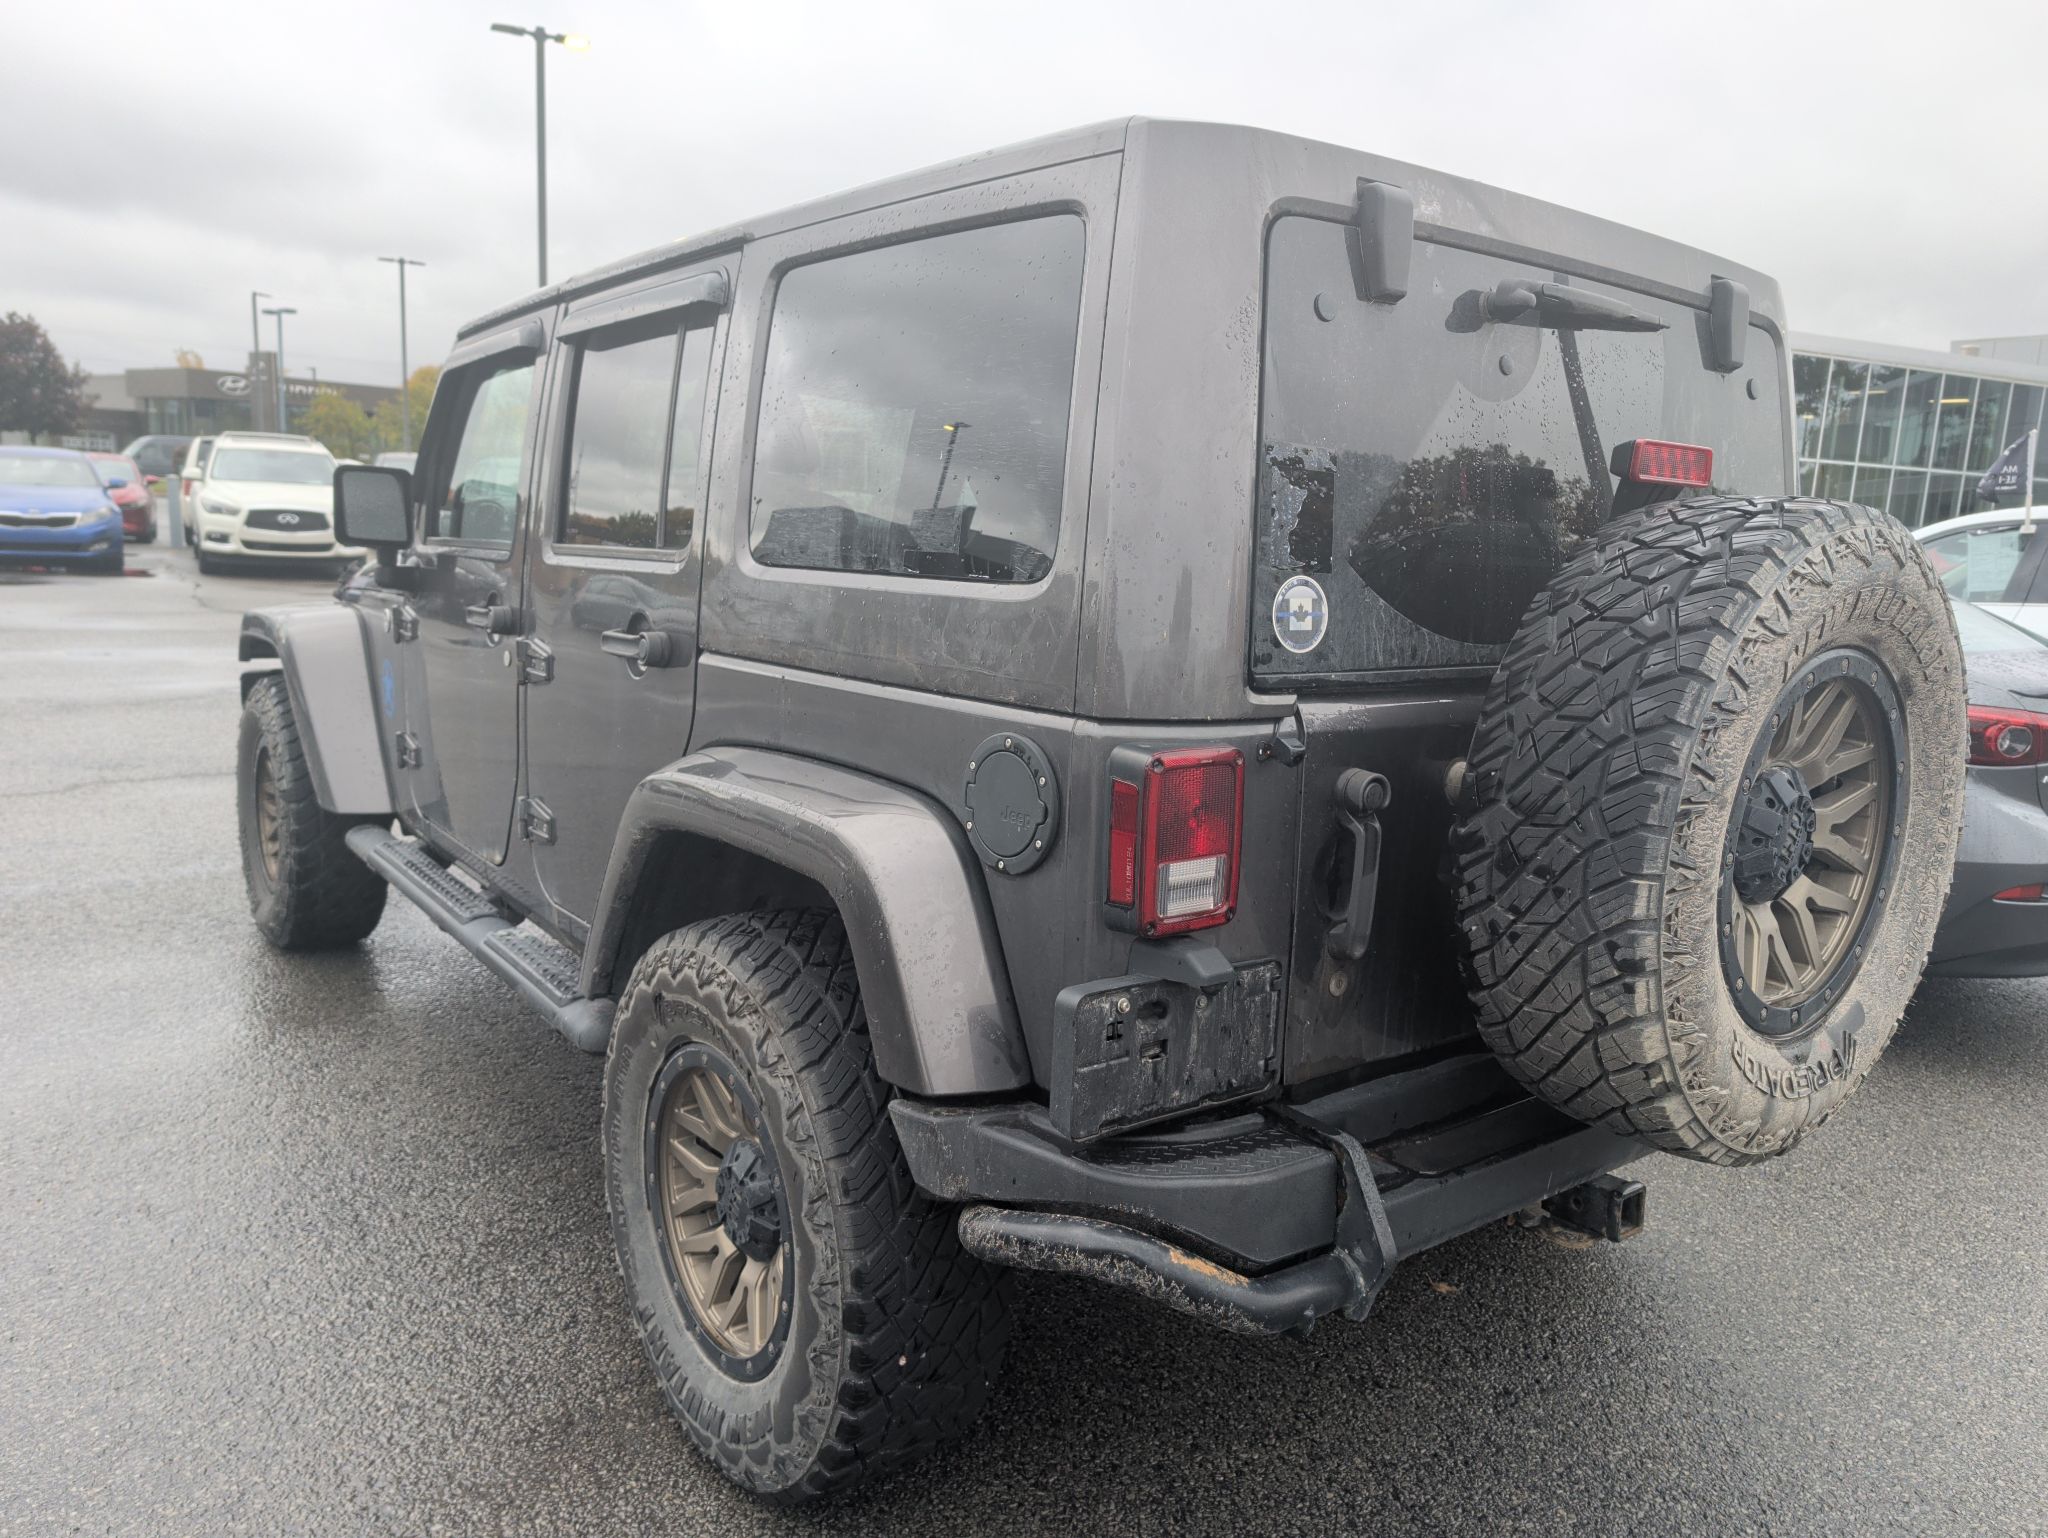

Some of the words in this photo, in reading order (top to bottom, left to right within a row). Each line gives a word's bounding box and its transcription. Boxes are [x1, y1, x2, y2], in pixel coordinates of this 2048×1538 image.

[1000, 804, 1033, 832] Jeep
[1730, 1030, 1846, 1102] PREDATOR
[637, 1304, 726, 1440] MUTANT
